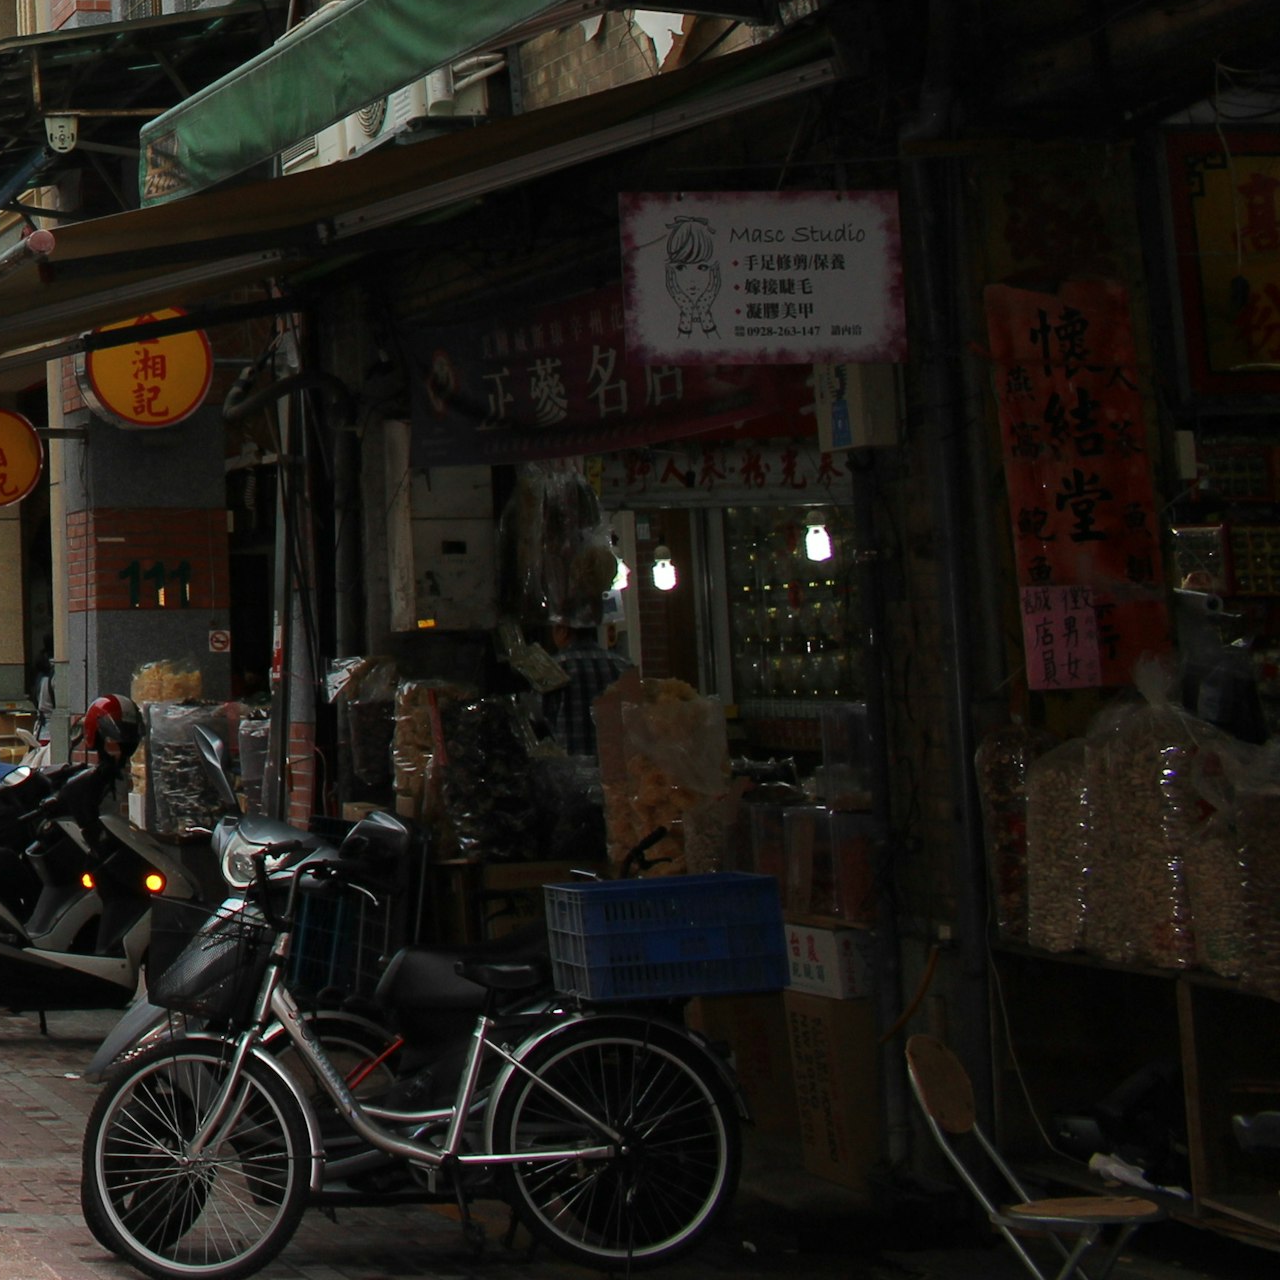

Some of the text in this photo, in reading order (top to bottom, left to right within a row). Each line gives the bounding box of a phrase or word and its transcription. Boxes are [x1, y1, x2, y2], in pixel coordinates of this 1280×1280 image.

[729, 222, 866, 244] Masc Studio
[743, 253, 845, 271] 手足修剪/保養
[743, 277, 813, 296] 嫁接睫毛
[745, 302, 814, 320] 凝膠美甲
[746, 325, 821, 337] 0928-263-147
[119, 559, 190, 609] 111
